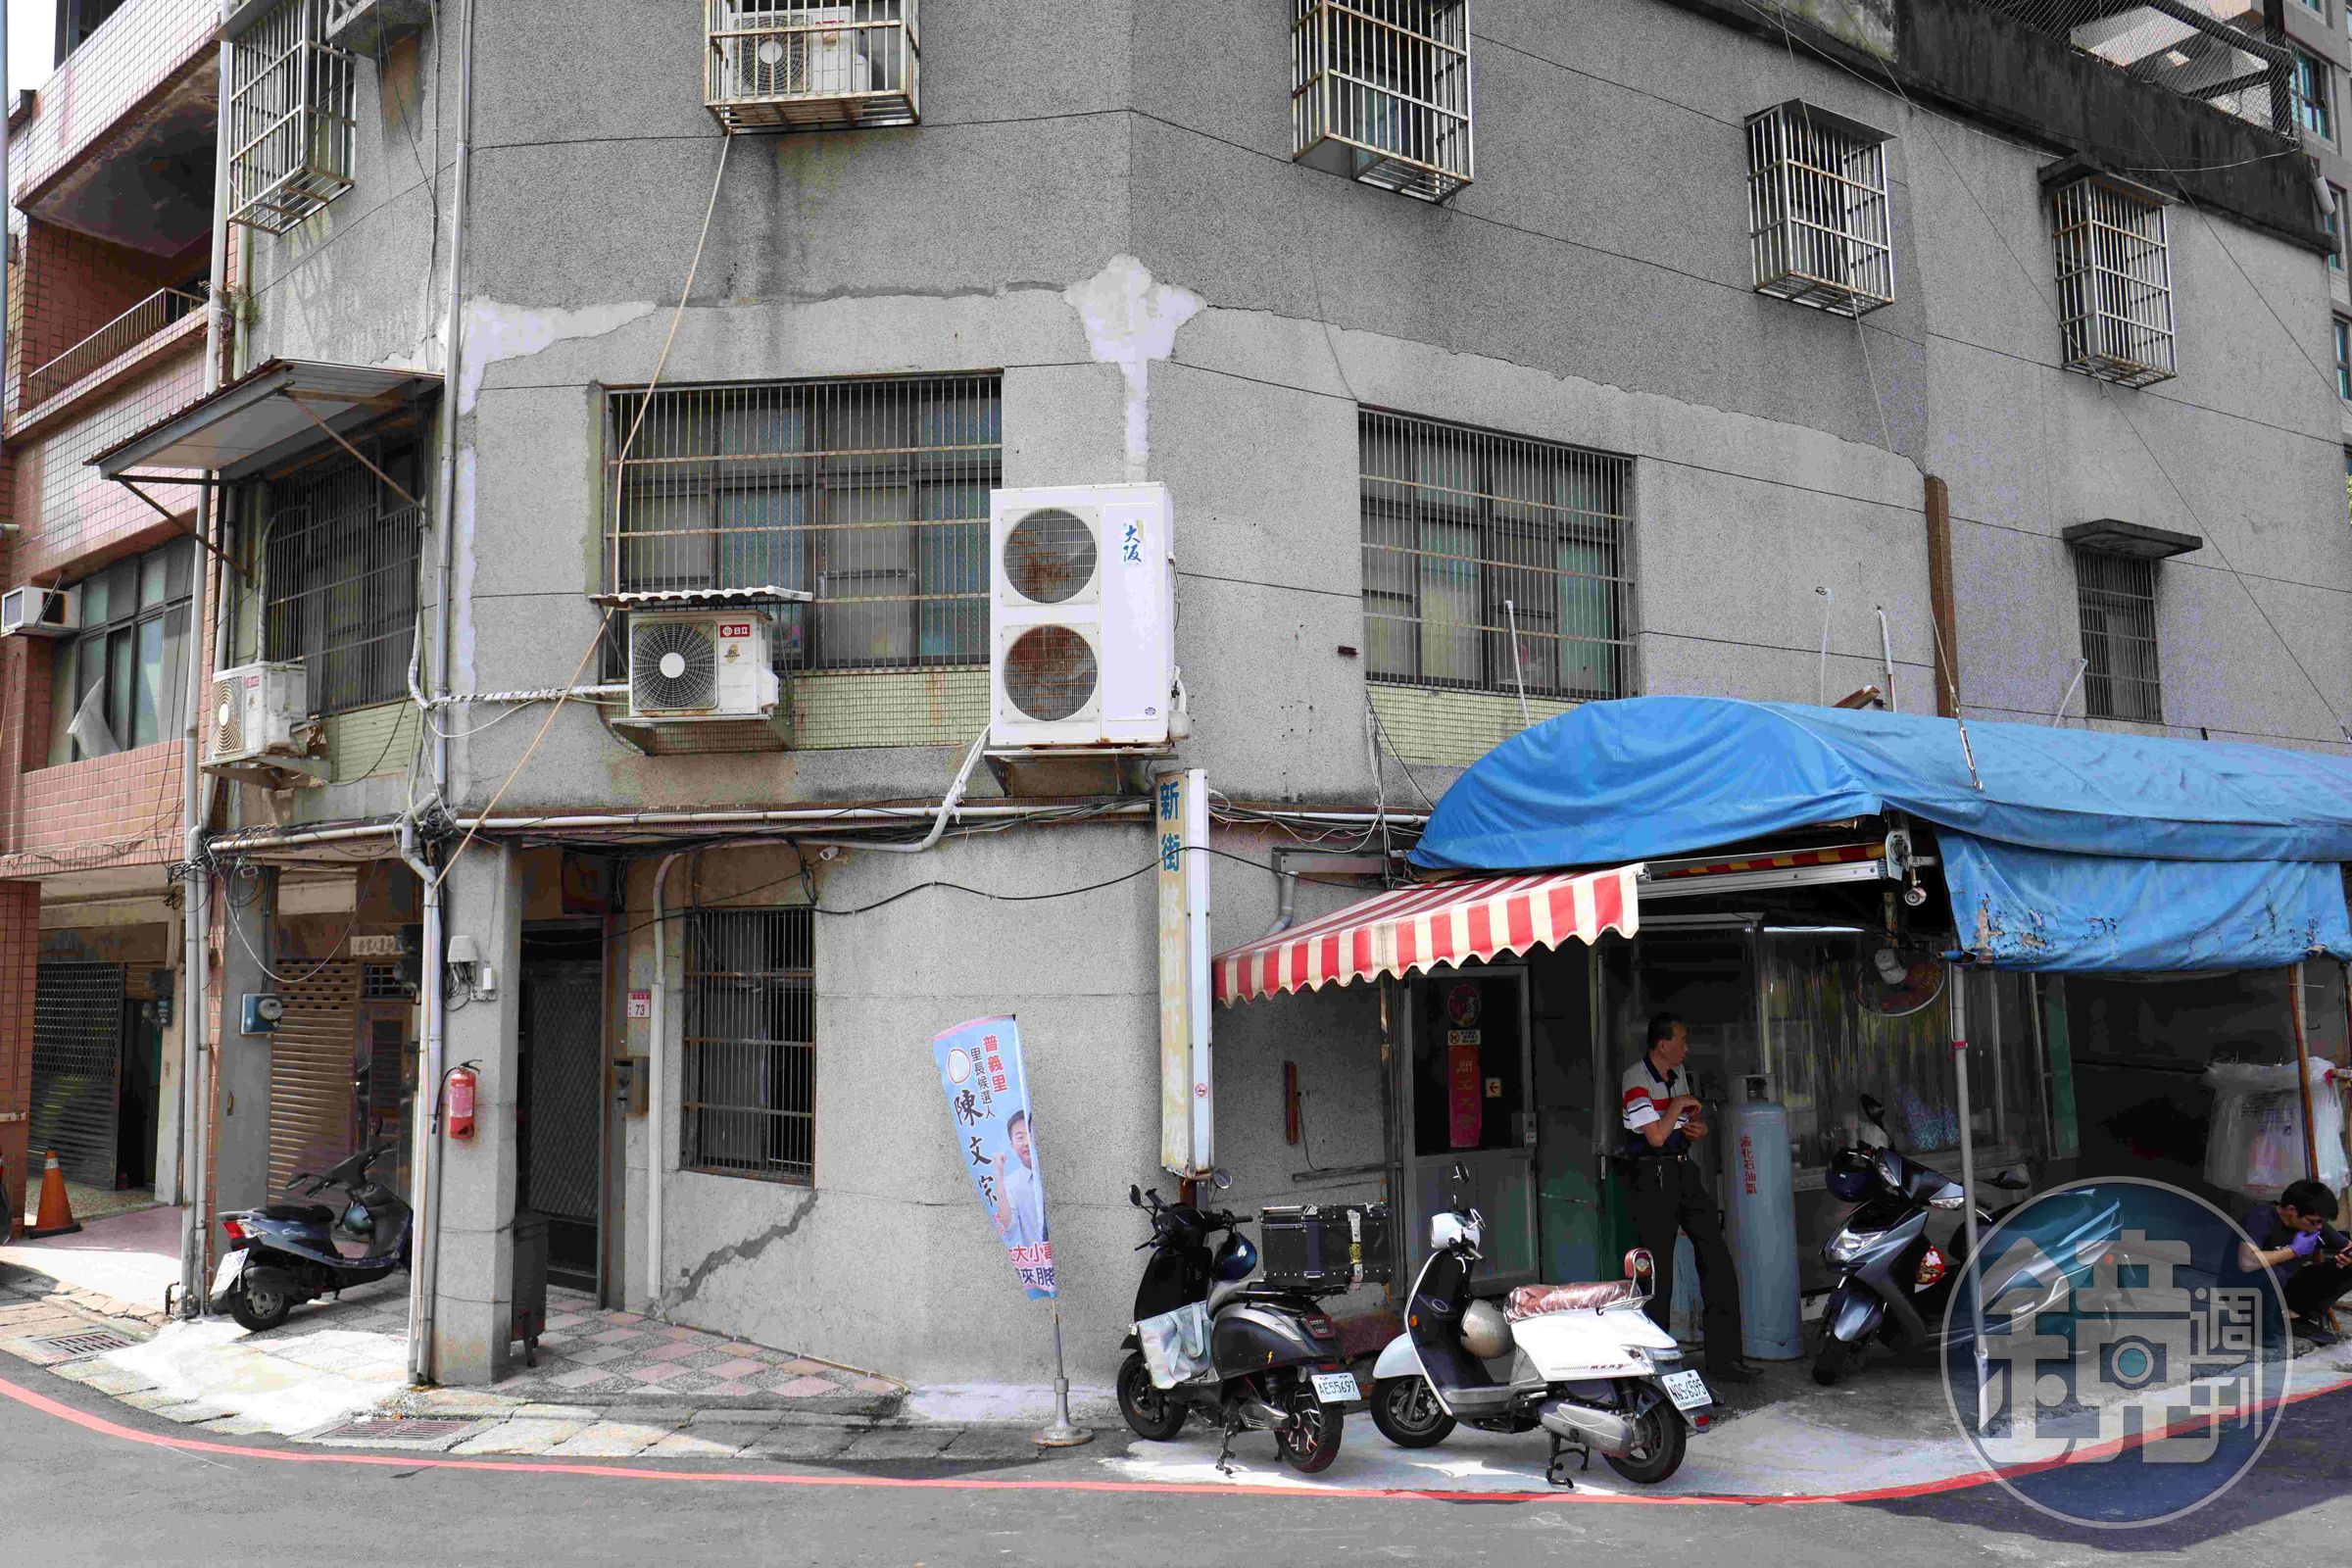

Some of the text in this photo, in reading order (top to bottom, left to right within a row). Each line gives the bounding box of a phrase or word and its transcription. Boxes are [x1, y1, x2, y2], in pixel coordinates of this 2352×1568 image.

[1123, 524, 1142, 563] 大阪
[1159, 781, 1181, 872] 新街
[635, 1004, 646, 1016] 73
[971, 1047, 996, 1119] 里長候選人
[983, 1035, 1008, 1093] 普義里
[954, 1089, 998, 1207] 陳文宗
[1740, 1135, 1757, 1195] 液化石油氣
[1317, 1380, 1355, 1396] AE55697
[1668, 1378, 1707, 1403] NQS-6595
